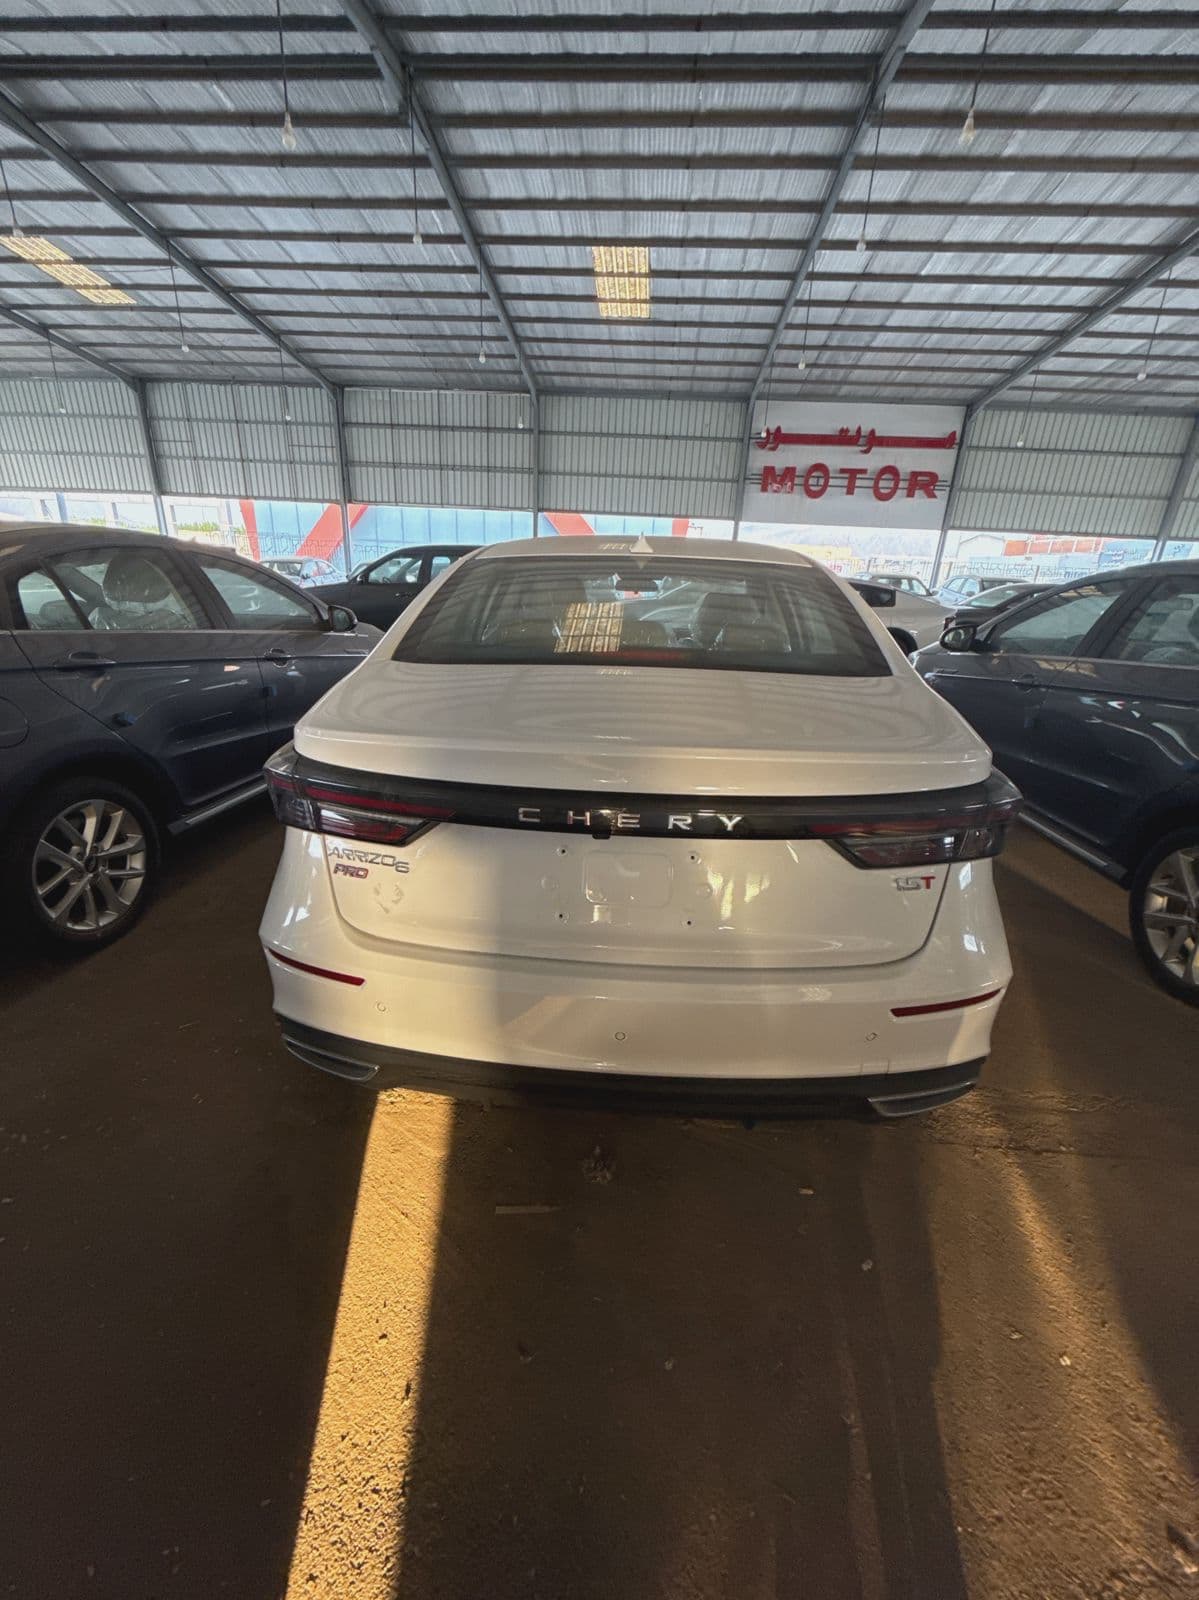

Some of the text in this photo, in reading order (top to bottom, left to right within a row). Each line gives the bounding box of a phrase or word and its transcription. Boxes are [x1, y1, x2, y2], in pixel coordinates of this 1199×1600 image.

[760, 462, 939, 502] MOTOR
[518, 807, 743, 831] CHERY
[333, 863, 369, 879] PRO
